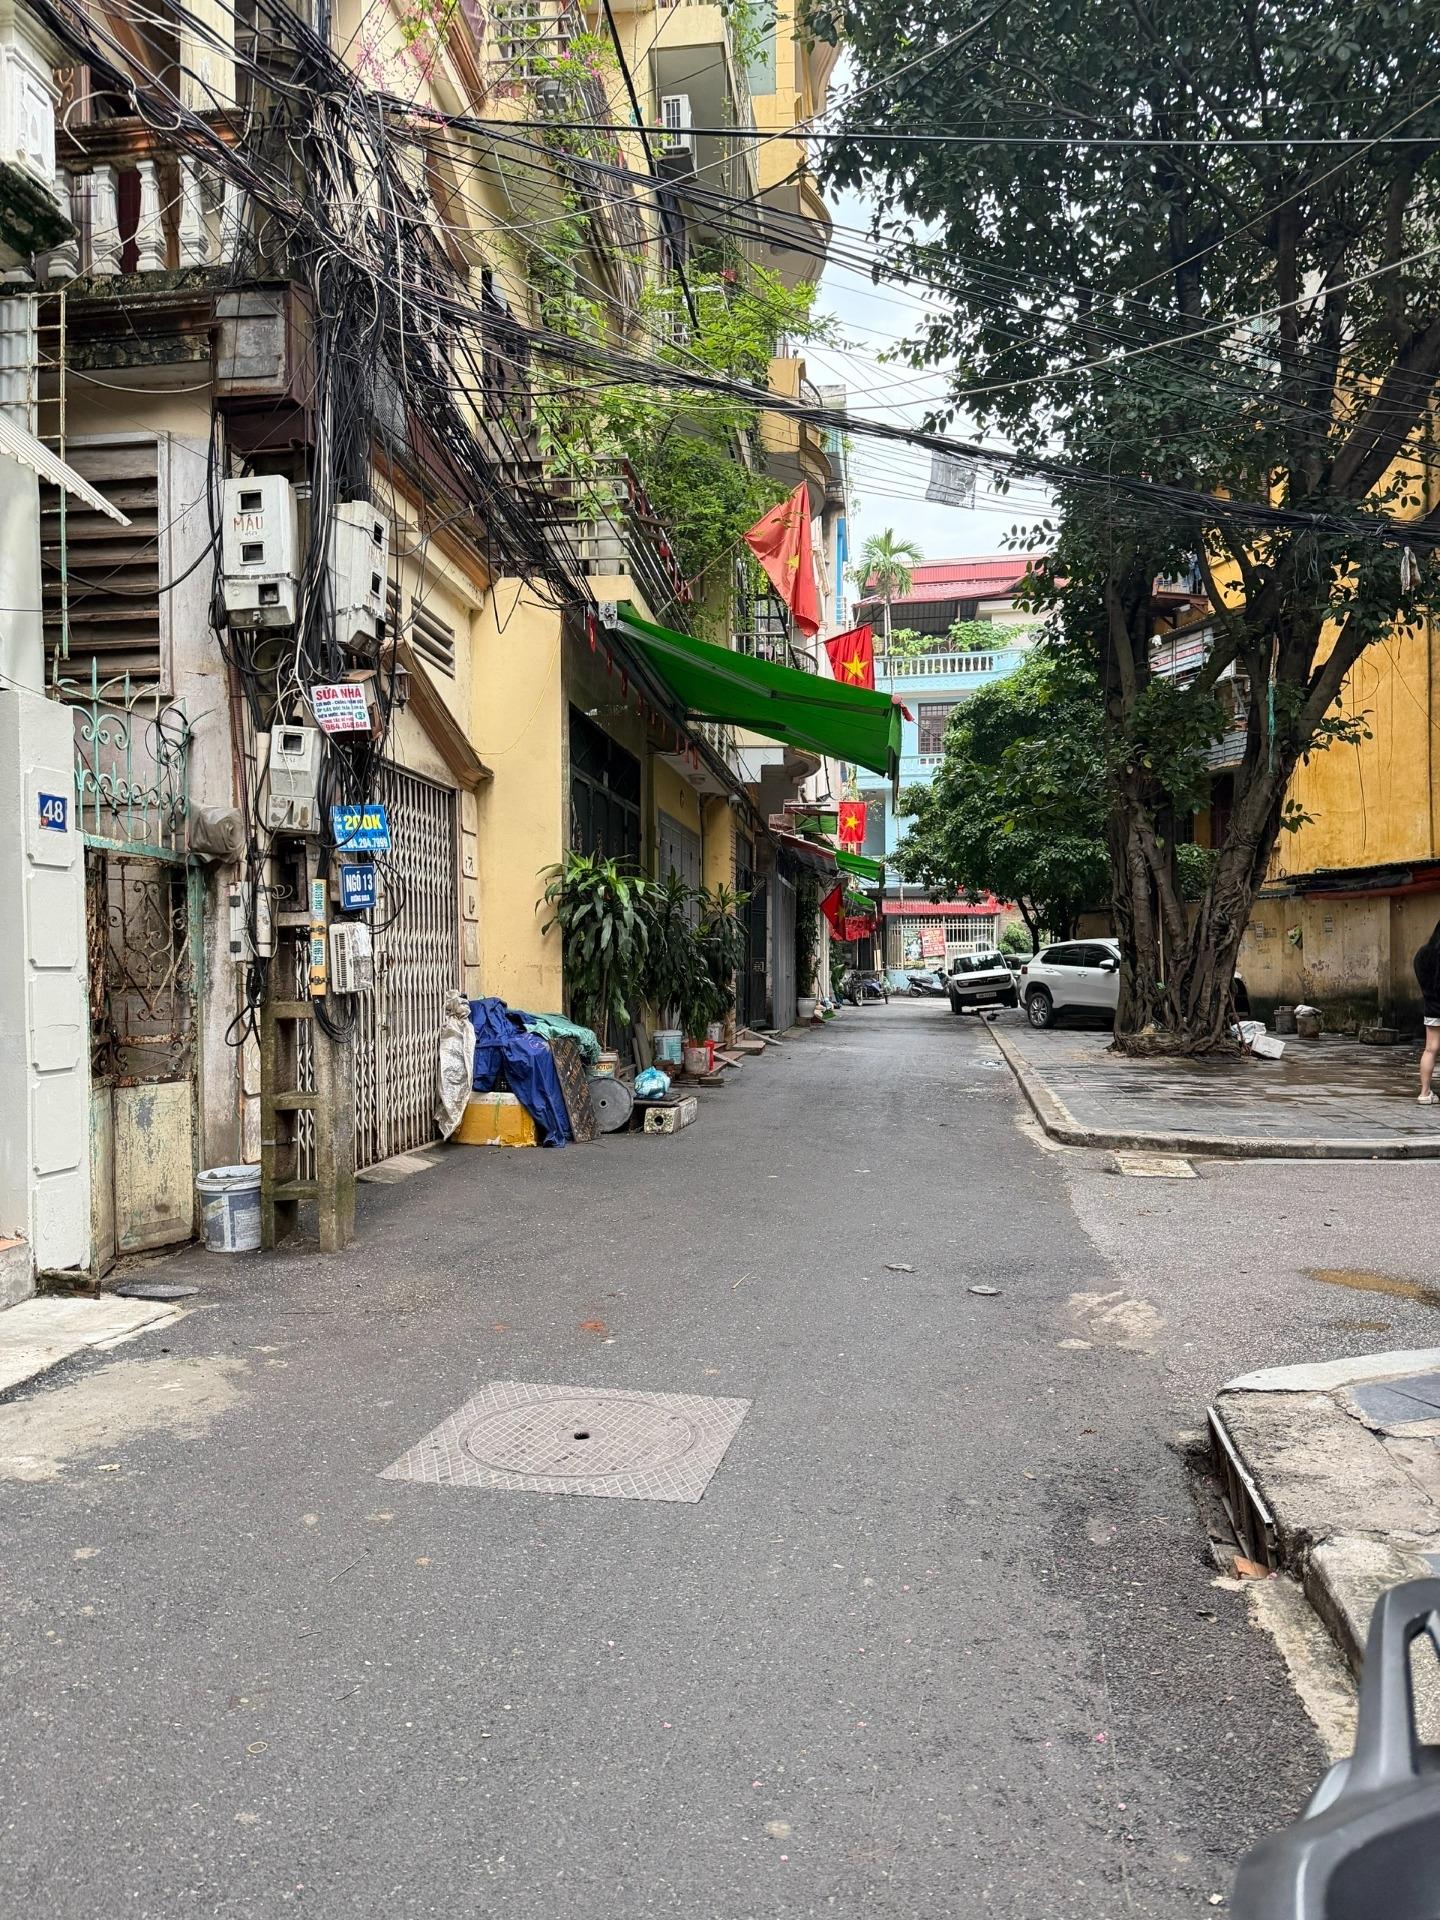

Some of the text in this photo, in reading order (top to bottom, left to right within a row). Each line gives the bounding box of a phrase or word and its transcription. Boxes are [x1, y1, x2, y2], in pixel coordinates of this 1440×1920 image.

[316, 686, 339, 701] SỬA
[43, 800, 64, 823] 48
[362, 873, 373, 891] 13
